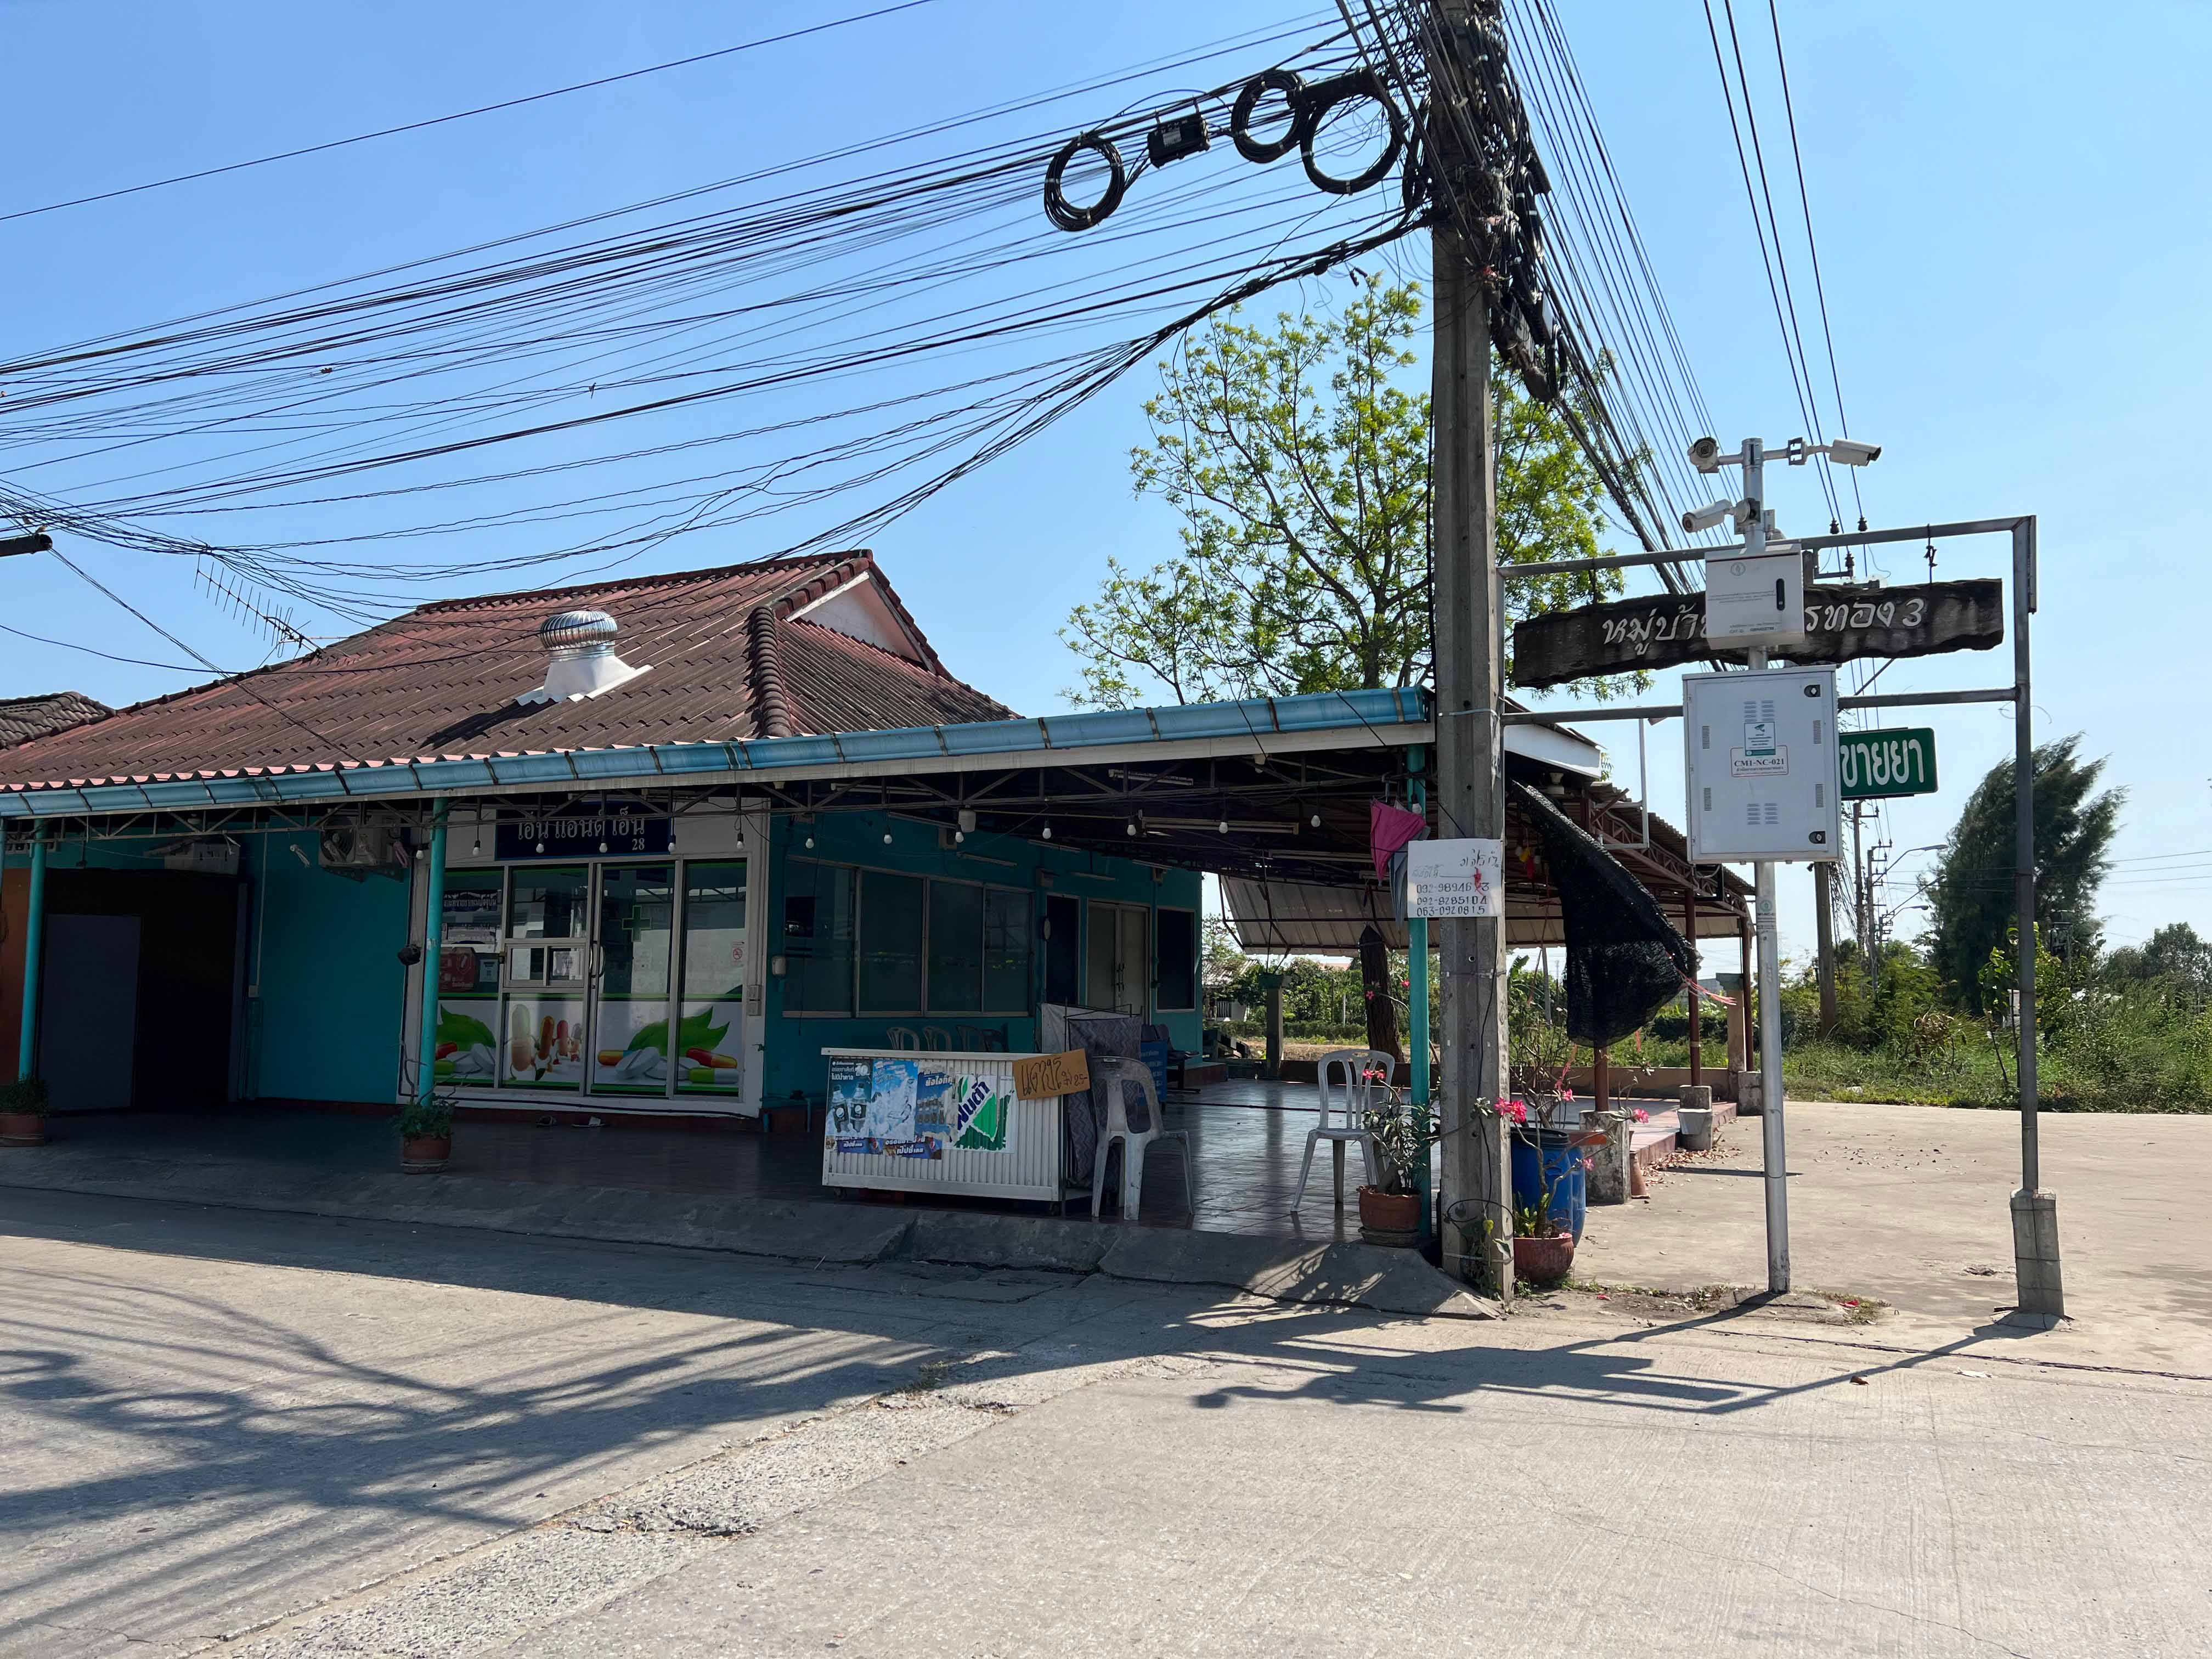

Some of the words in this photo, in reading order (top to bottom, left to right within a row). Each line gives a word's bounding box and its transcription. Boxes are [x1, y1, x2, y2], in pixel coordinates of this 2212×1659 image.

[1902, 598, 1925, 627] 3
[1840, 738, 1924, 788] ขายยา
[631, 838, 645, 851] 28
[1416, 882, 1489, 894] 092-989463
